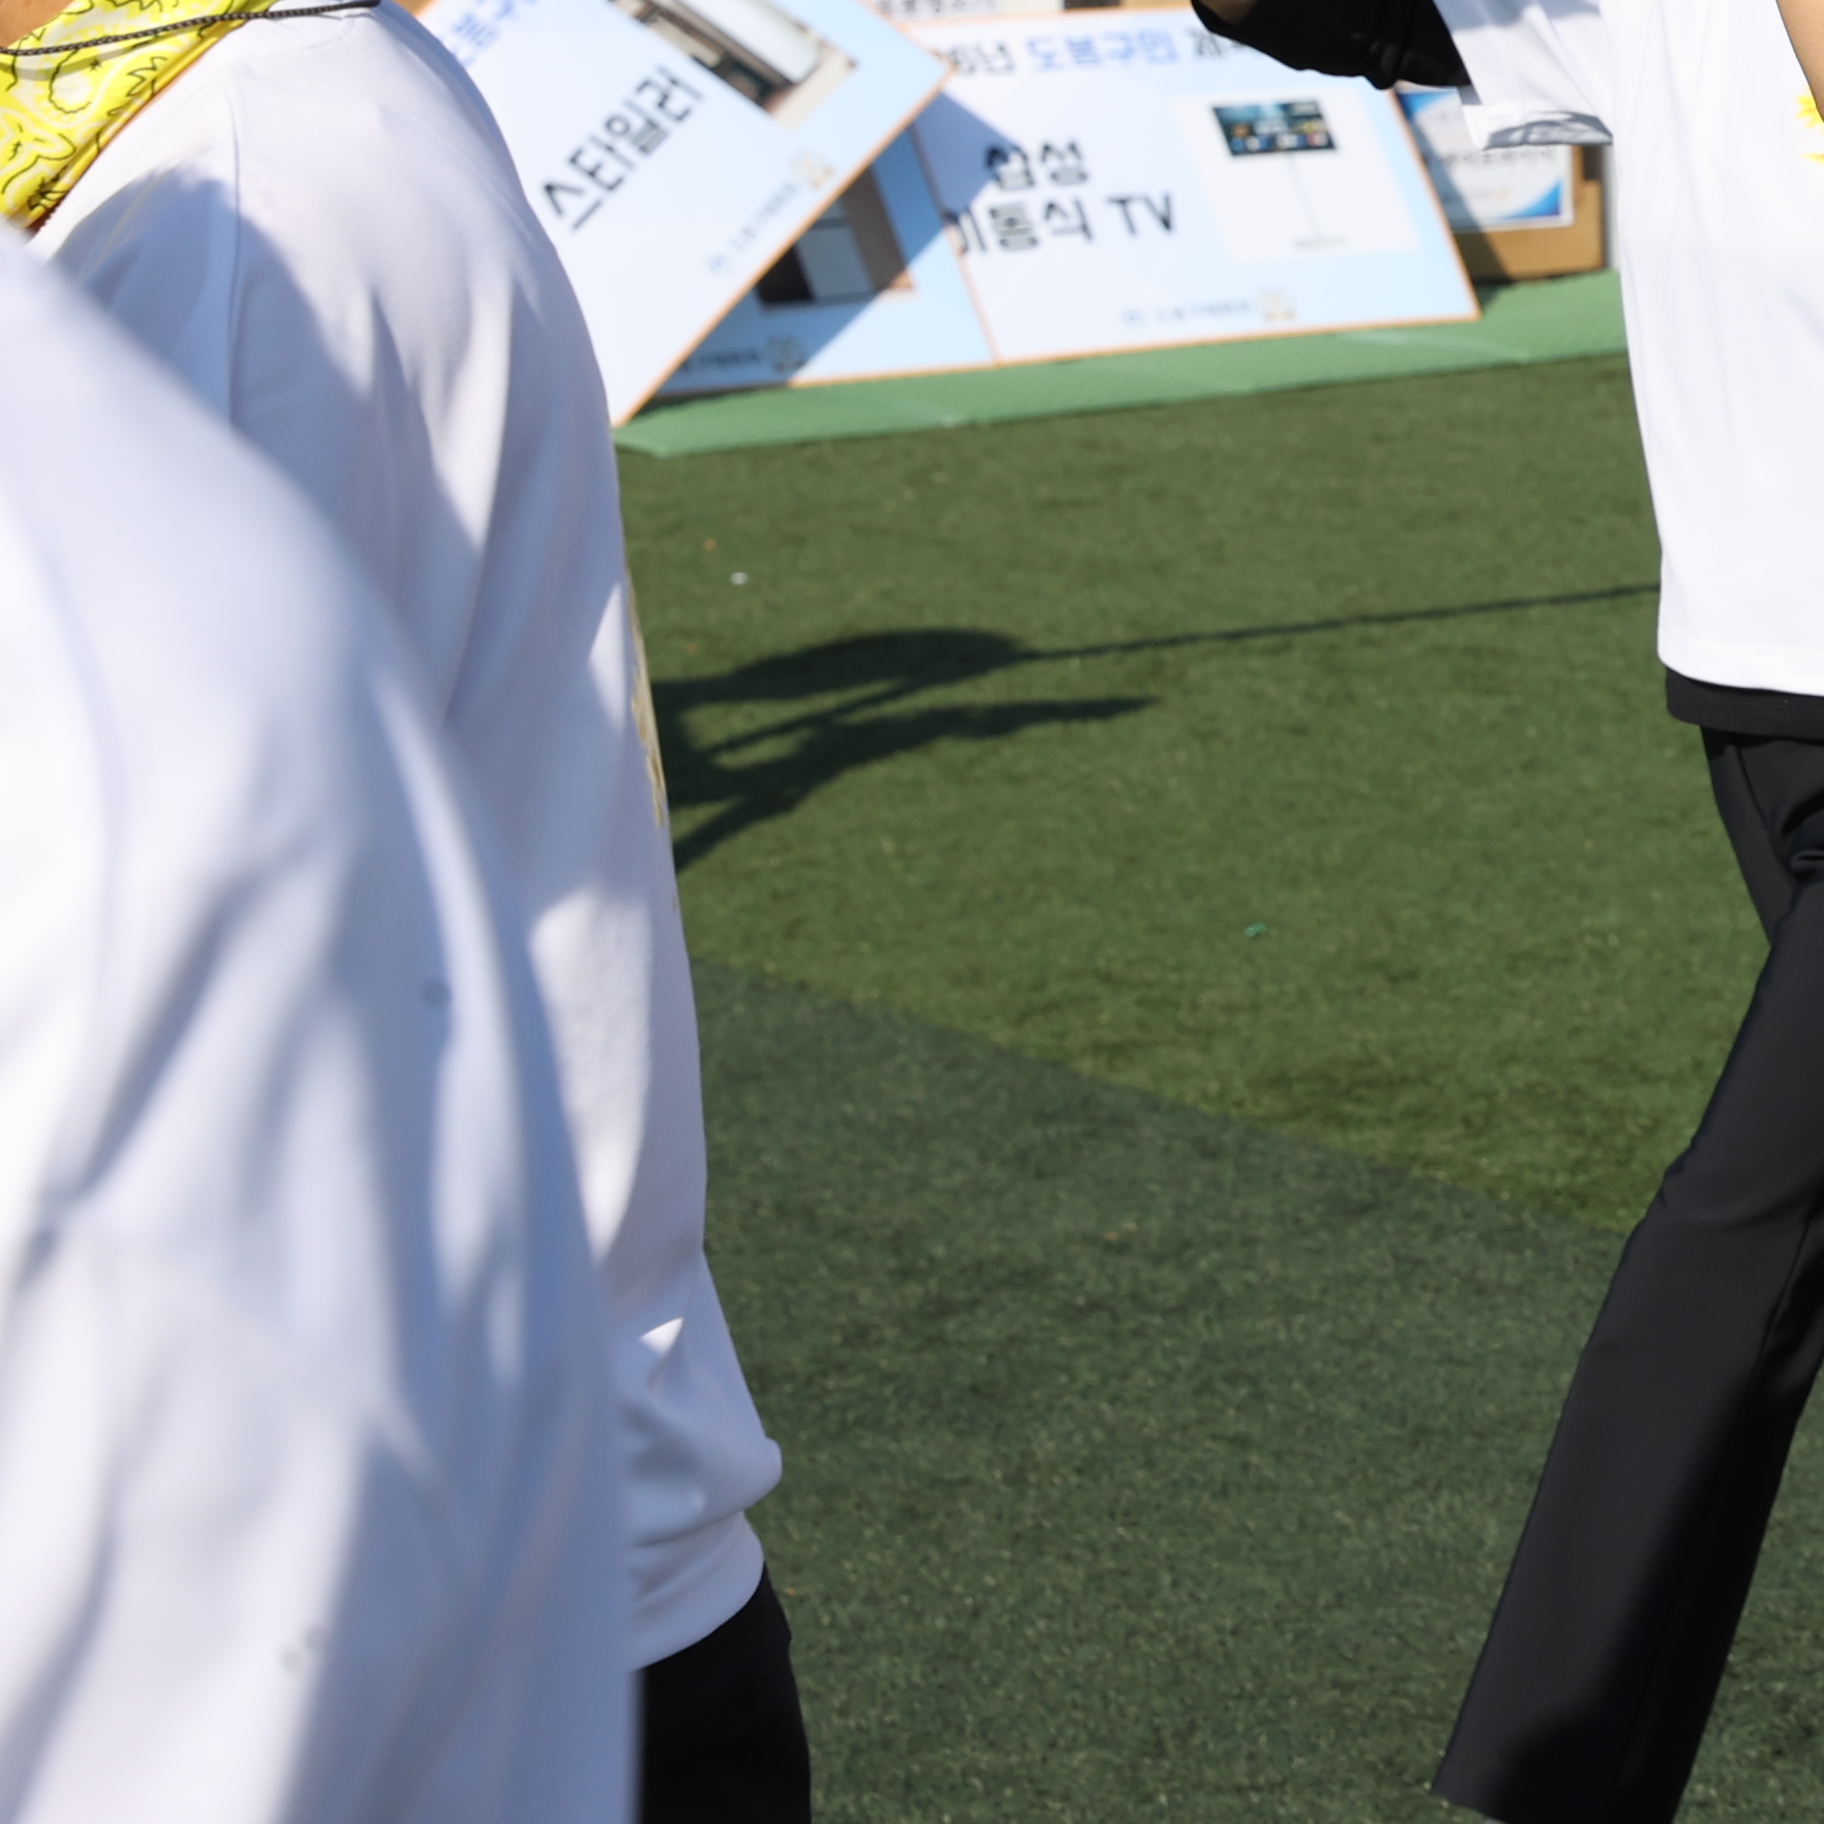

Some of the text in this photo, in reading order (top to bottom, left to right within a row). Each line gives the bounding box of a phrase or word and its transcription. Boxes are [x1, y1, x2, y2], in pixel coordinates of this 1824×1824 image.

[1026, 29, 1179, 72] 도봉구민
[540, 64, 706, 234] 스타일러
[985, 140, 1089, 192] 삼성
[1106, 193, 1172, 234] TV
